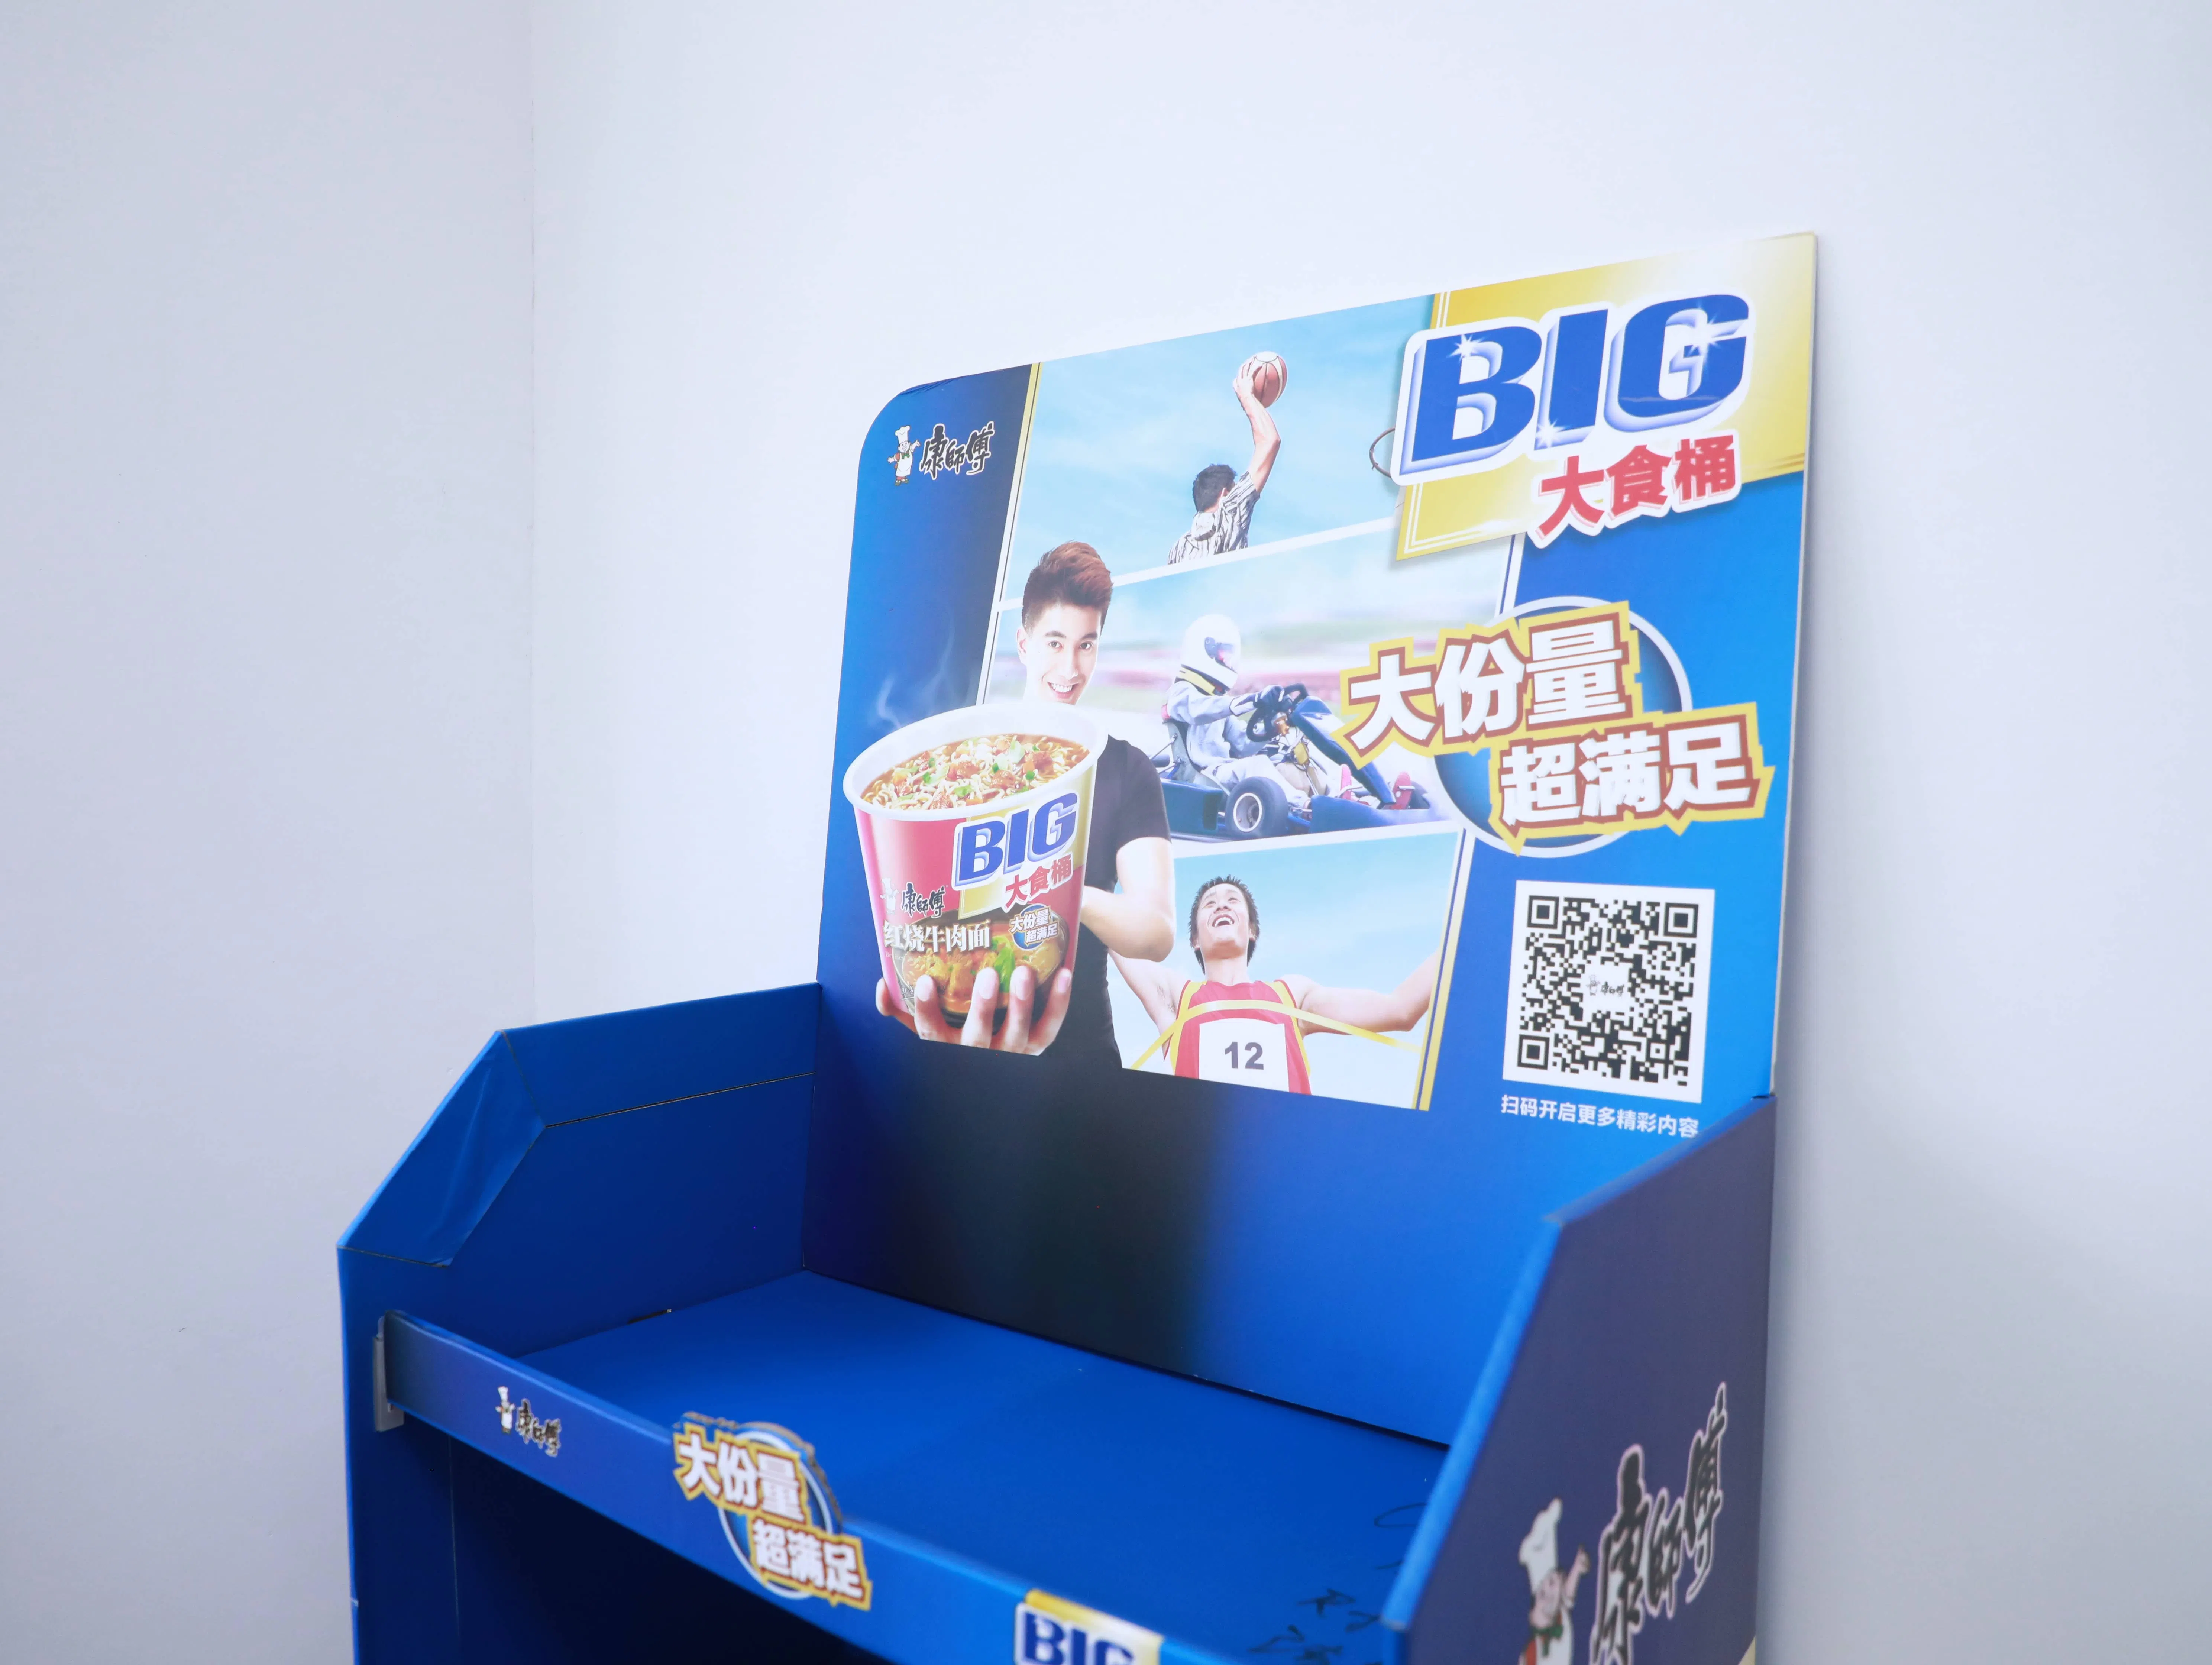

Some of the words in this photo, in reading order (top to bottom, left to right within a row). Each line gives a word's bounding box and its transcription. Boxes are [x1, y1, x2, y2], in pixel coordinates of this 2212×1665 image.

[1400, 294, 1749, 476] BIG
[1535, 434, 1736, 539] 大食桶
[1349, 619, 1627, 750] 大份量
[1500, 721, 1752, 827] 超满足
[958, 793, 1077, 884] BIG
[1005, 854, 1071, 909] 大食桶
[1010, 909, 1050, 933] 大份量
[883, 919, 990, 953] 红烧牛肉面
[1026, 923, 1057, 943] 超满足
[1225, 1042, 1264, 1070] 12
[1501, 1094, 1699, 1138] 扫码开启更多精彩内容
[678, 1433, 806, 1523] 大份量
[753, 1517, 864, 1598] 超满足
